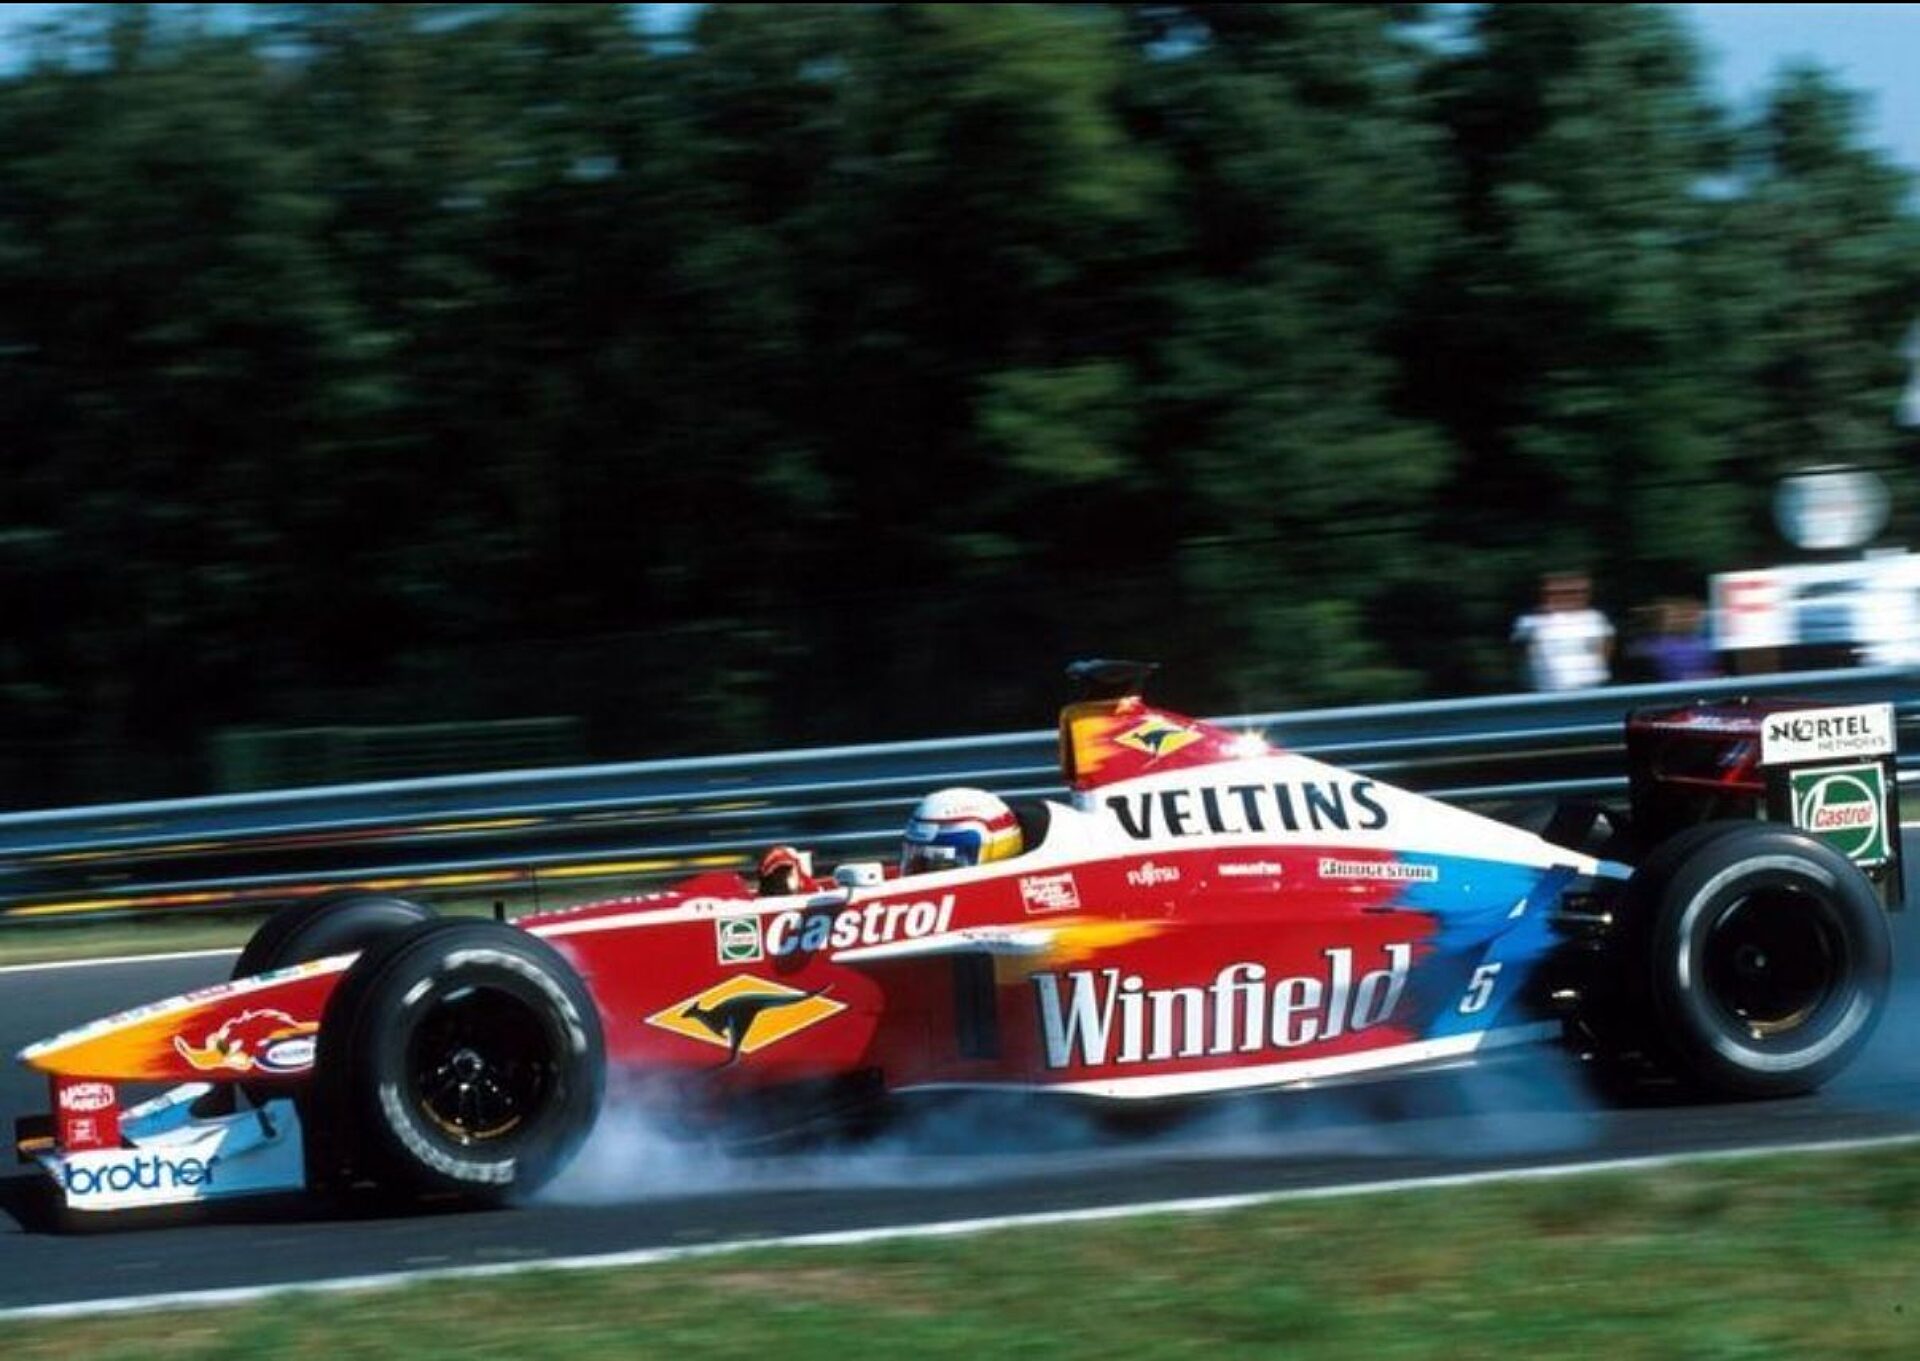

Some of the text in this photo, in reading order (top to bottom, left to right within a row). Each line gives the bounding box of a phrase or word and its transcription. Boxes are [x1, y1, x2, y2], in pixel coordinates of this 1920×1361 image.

[1769, 715, 1871, 742] NORTEL
[1106, 781, 1389, 840] VELTINS
[1815, 803, 1873, 828] Castrol
[766, 894, 956, 955] Castrol
[1030, 943, 1413, 1070] Winfield
[1457, 963, 1502, 1014] 5
[64, 1154, 219, 1195] brother
